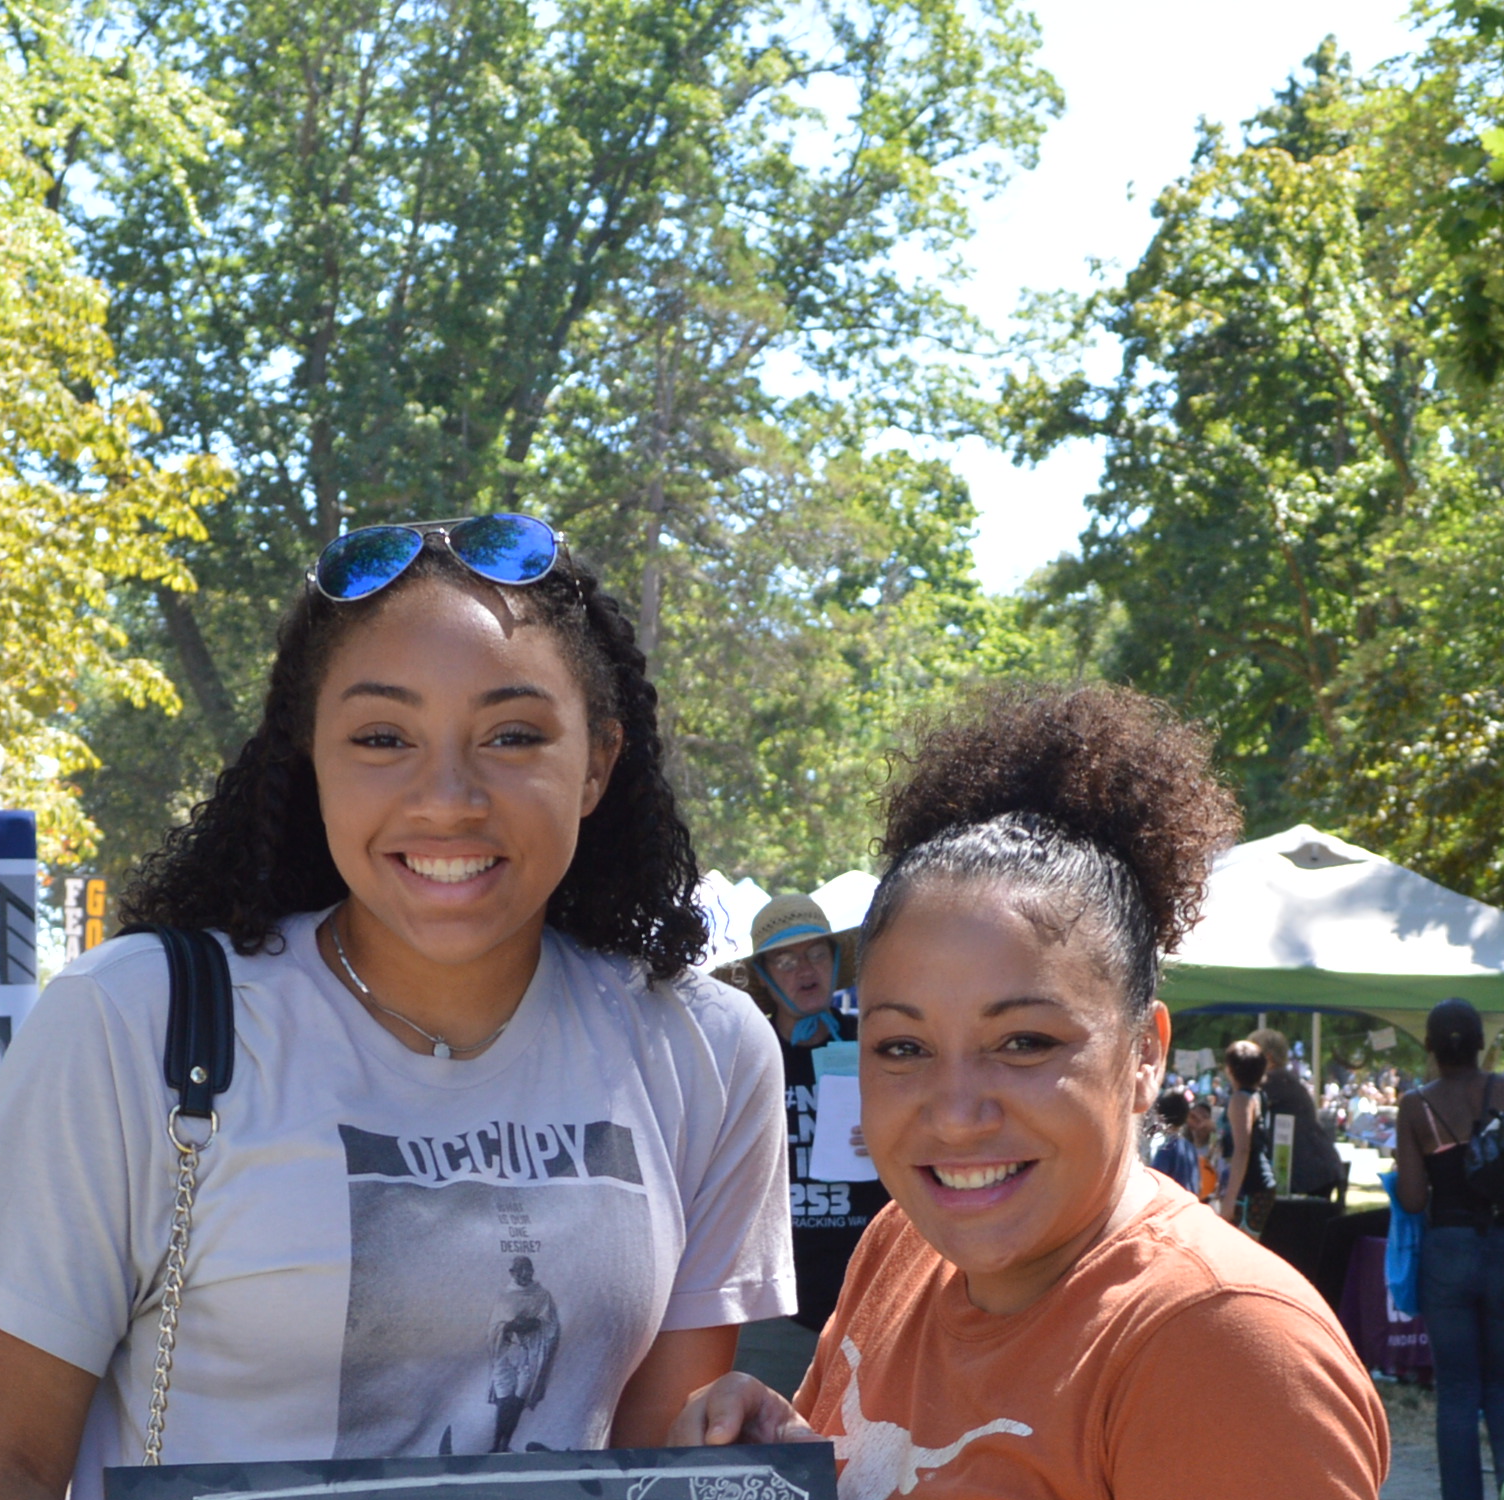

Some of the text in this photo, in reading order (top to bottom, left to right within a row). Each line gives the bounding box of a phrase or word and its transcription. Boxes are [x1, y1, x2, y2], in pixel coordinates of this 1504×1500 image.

[397, 1120, 590, 1182] OCCUPY
[508, 1226, 529, 1238] ONE
[500, 1240, 541, 1253] DESIRE?
